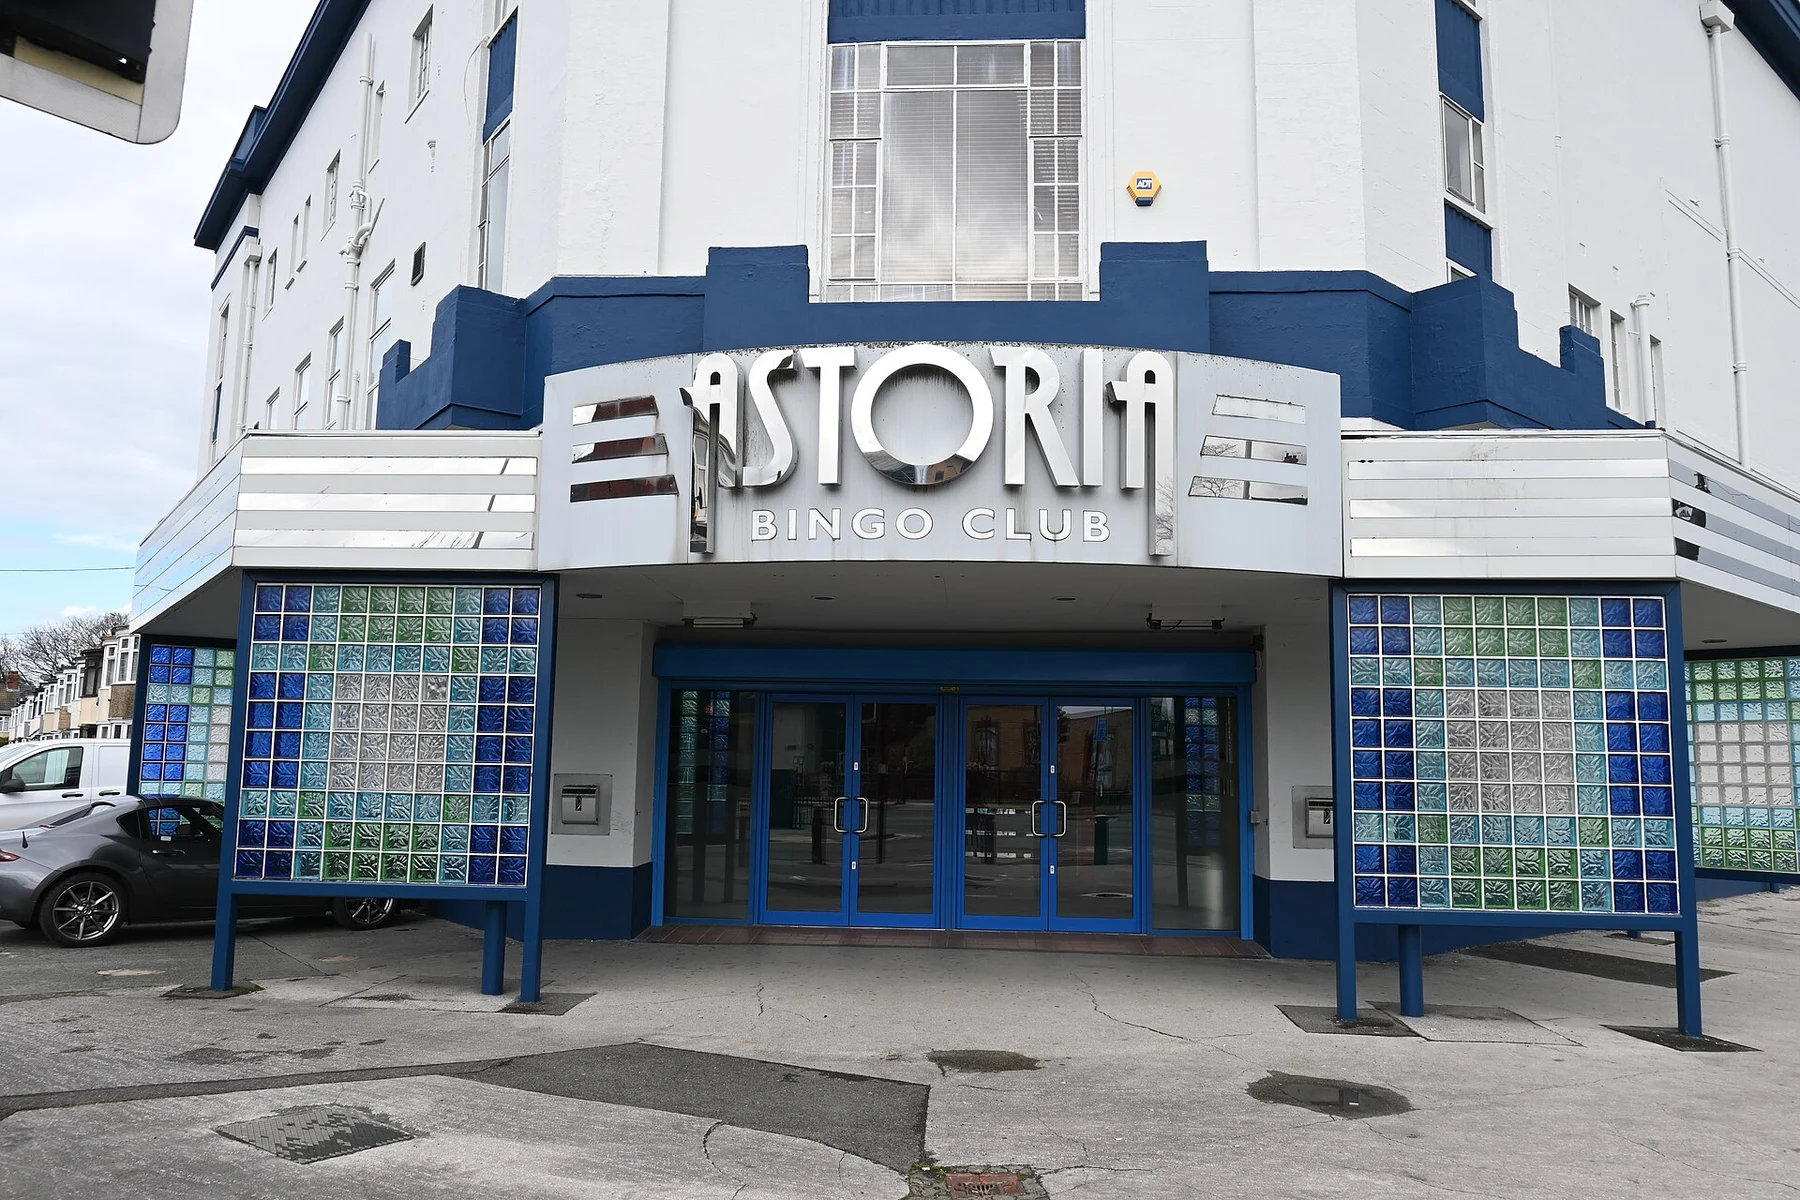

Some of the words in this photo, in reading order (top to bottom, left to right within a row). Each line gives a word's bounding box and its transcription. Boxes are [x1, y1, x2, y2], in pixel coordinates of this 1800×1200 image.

[1137, 179, 1152, 188] ADT
[680, 343, 1174, 556] ASTORIA
[752, 508, 933, 541] BINGO
[962, 508, 1111, 542] CLUB
